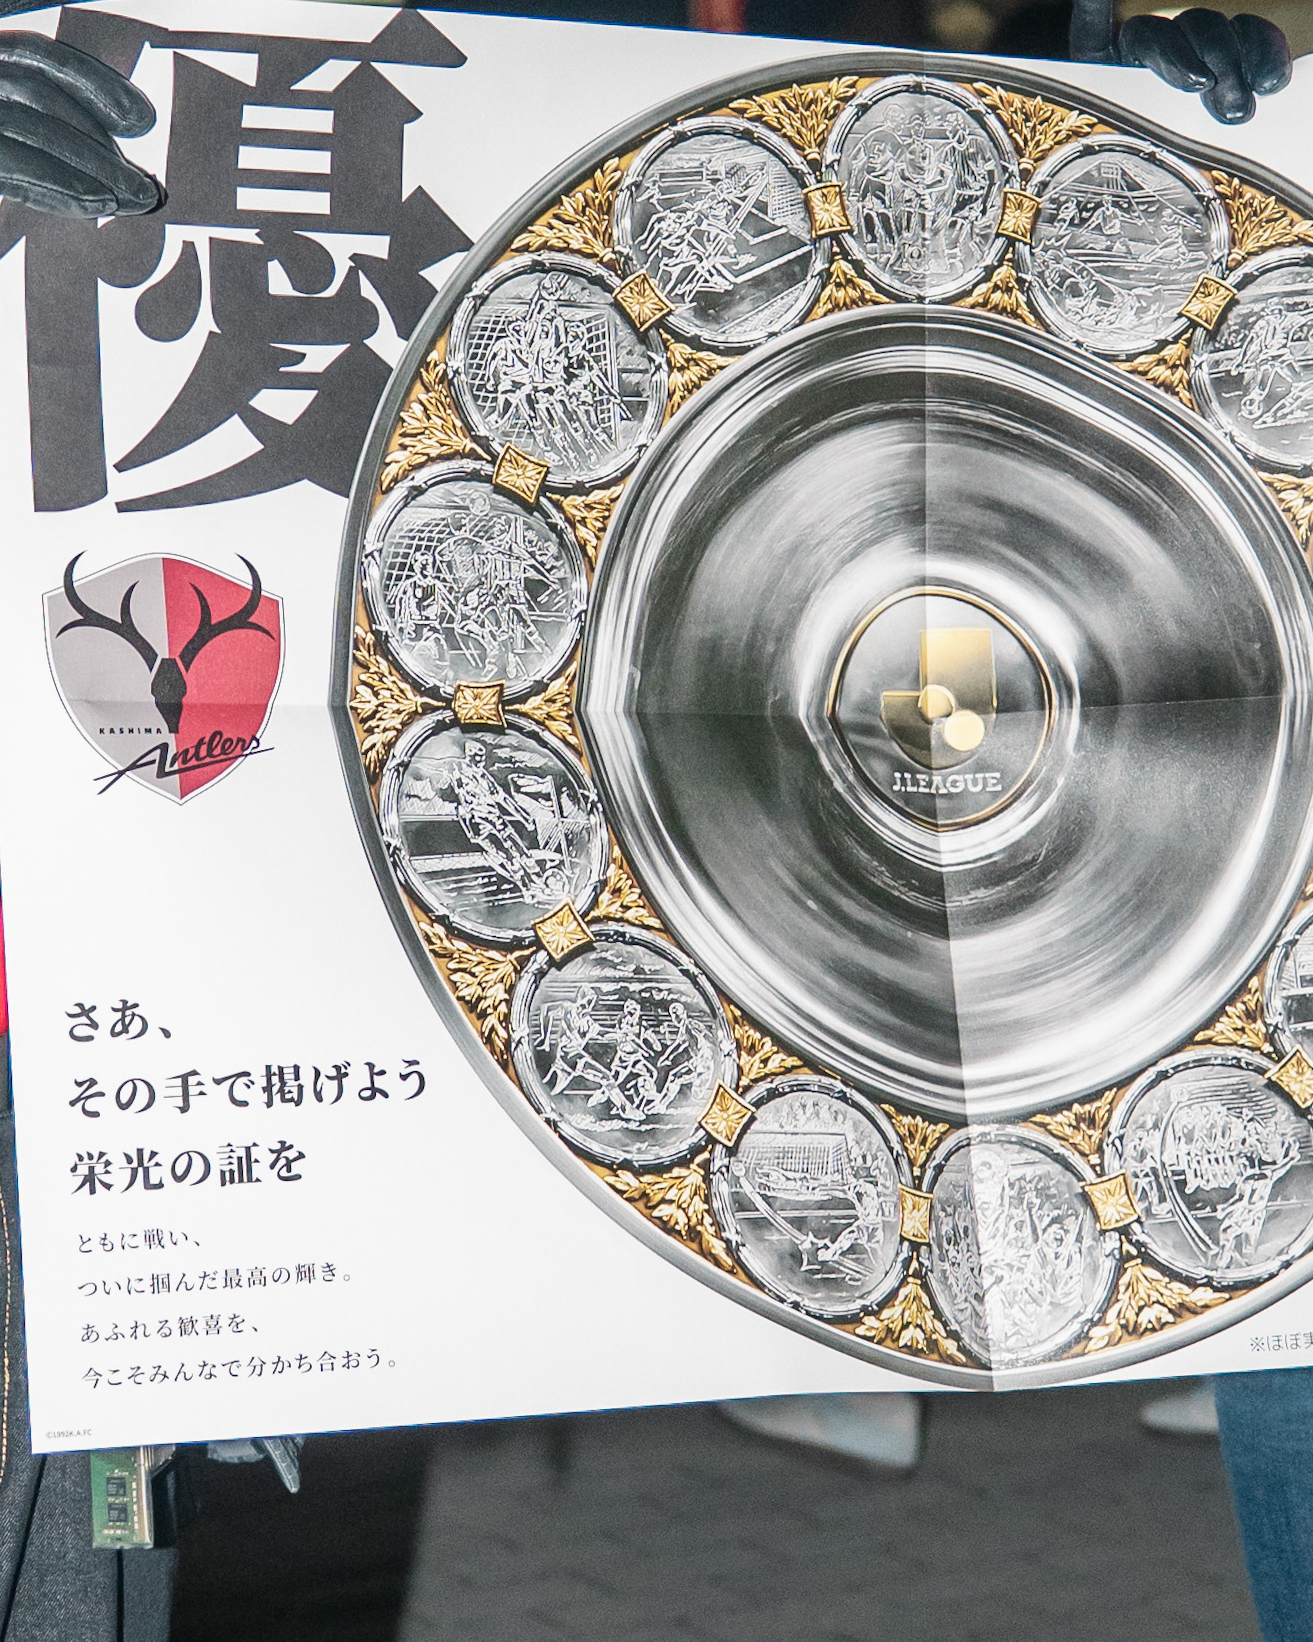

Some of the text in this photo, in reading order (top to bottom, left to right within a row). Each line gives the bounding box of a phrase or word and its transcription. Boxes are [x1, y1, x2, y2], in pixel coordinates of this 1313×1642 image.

[99, 727, 162, 735] KASHIMA
[93, 730, 275, 796] Antlers
[892, 772, 1002, 794] J.LEAGUE
[64, 998, 172, 1043] さあ、
[68, 1058, 426, 1119] その手で掲げよう
[69, 1140, 306, 1196] 栄光の証を
[78, 1227, 201, 1254] ともに戦い、
[77, 1261, 352, 1297] ついに掴んだ最高の輝き。
[80, 1313, 259, 1344] あふれる歓喜を、
[82, 1348, 397, 1389] 今こそみんなで分かち合おう。
